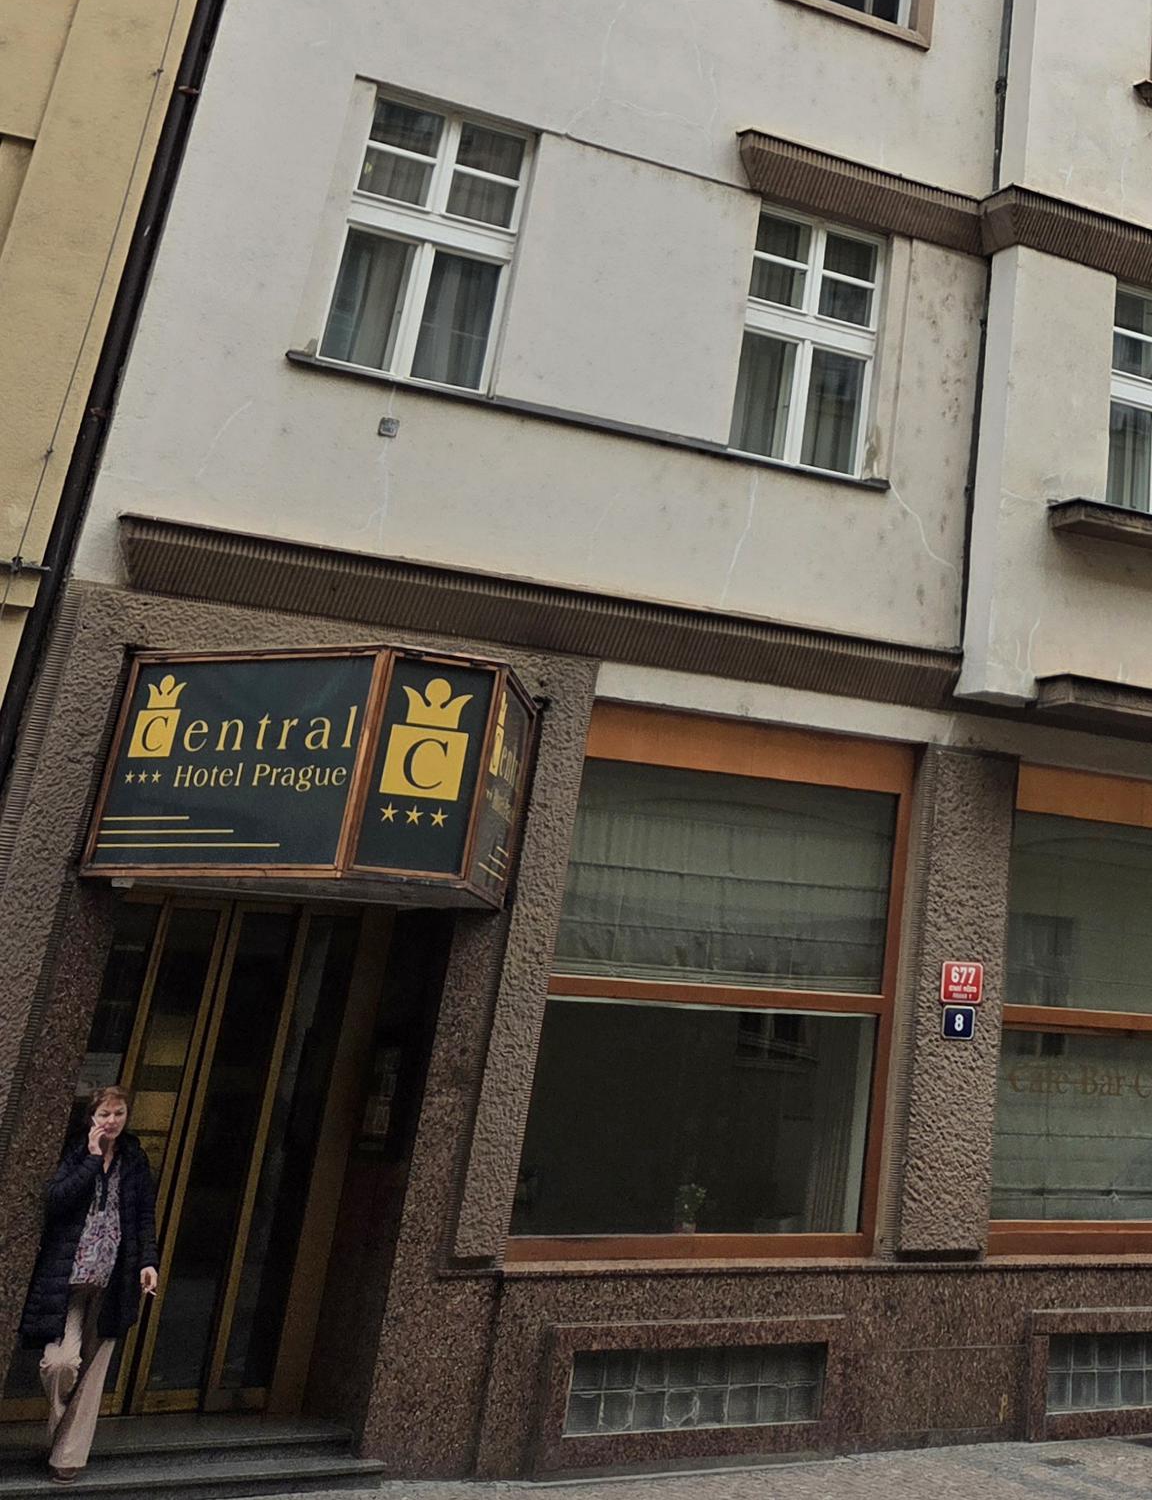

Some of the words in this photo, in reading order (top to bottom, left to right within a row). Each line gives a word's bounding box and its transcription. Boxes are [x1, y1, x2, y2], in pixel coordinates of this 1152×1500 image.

[132, 705, 359, 756] Central
[173, 763, 243, 789] Hotel
[252, 763, 348, 793] Prague
[402, 737, 450, 791] C
[951, 966, 976, 984] 677
[954, 1013, 964, 1032] 8
[1080, 1067, 1125, 1097] Bar
